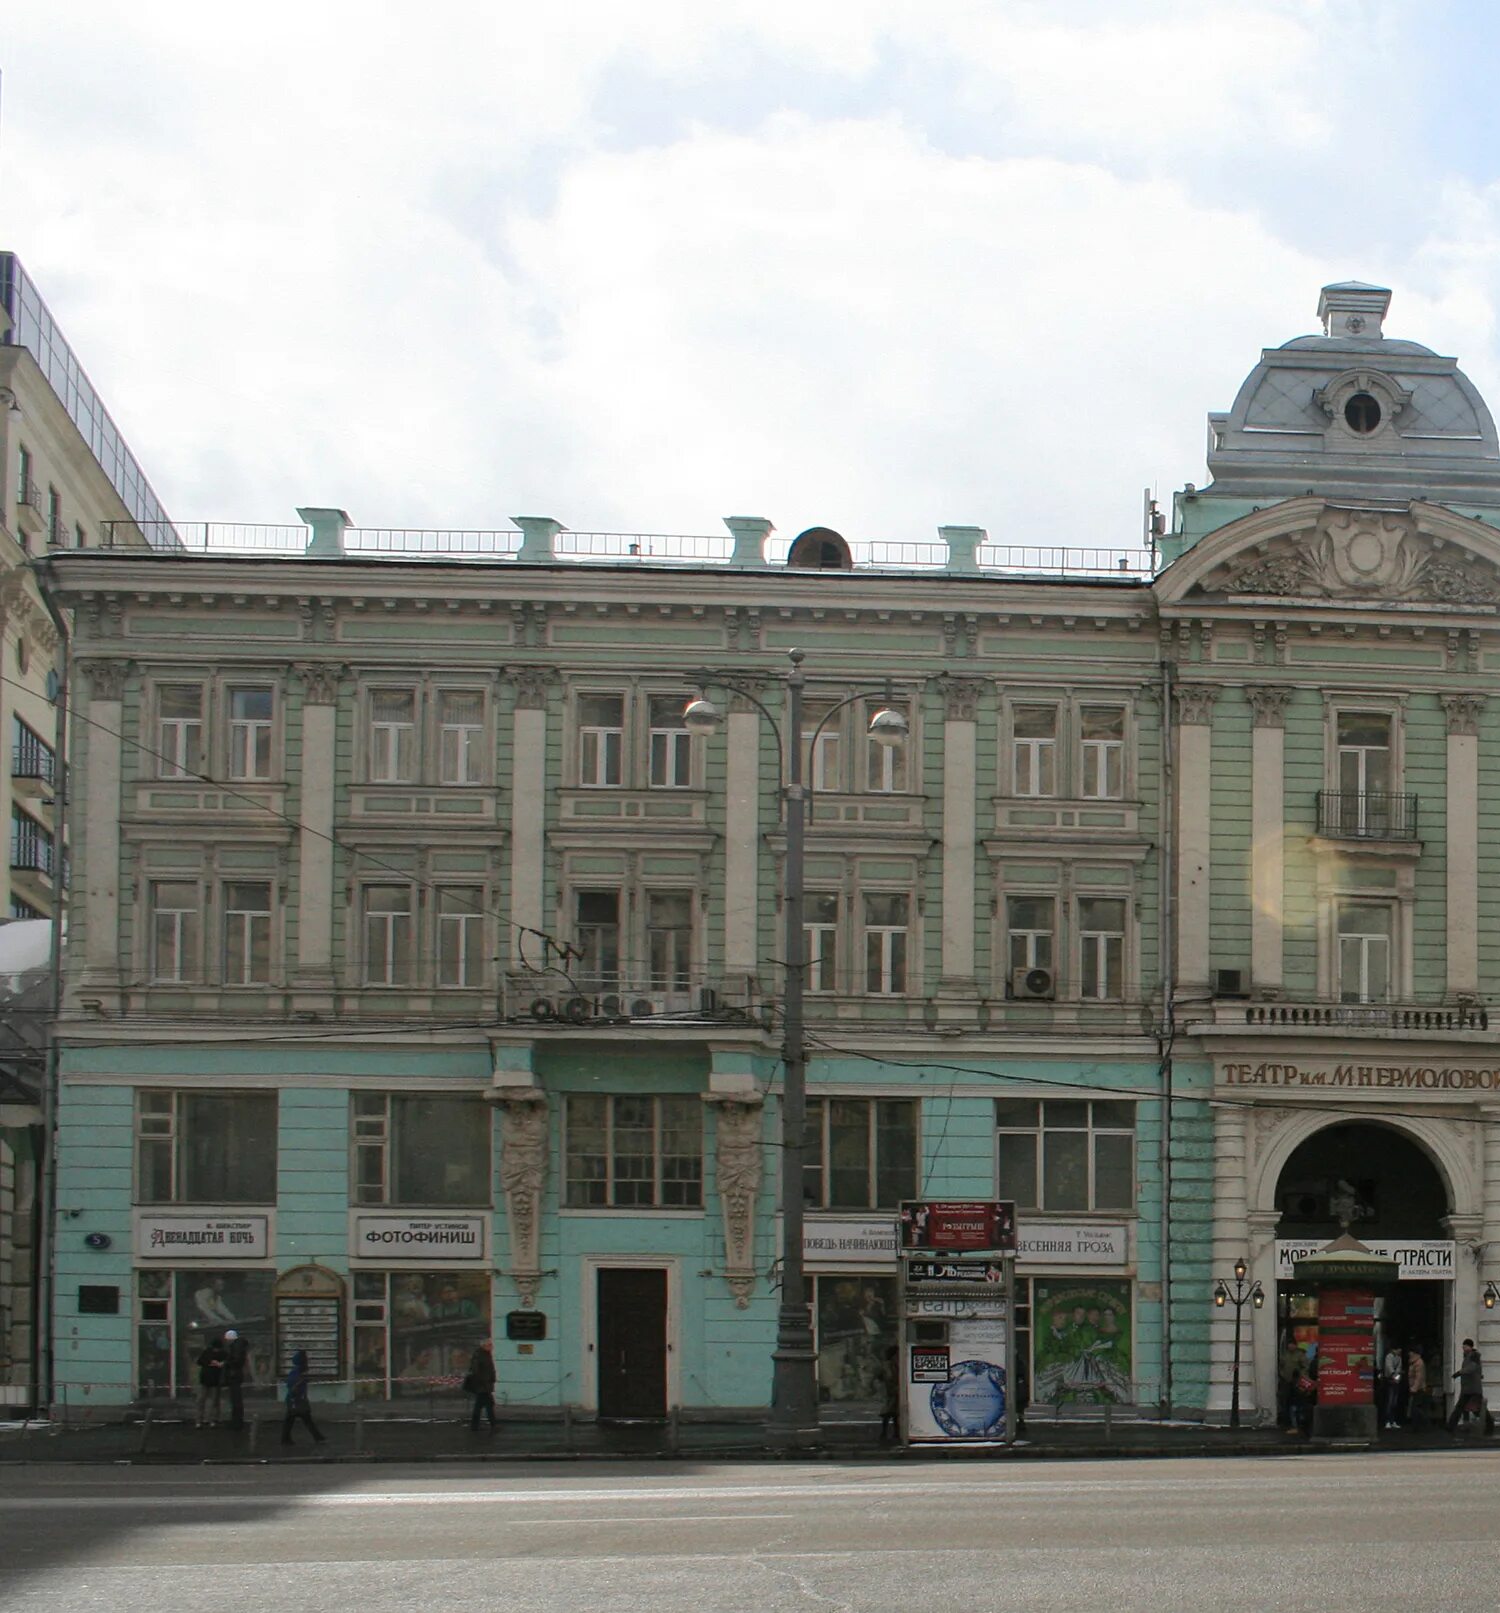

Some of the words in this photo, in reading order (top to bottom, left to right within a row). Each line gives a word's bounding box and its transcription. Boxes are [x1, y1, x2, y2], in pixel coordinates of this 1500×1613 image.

[1222, 1062, 1298, 1085] ТЕАТР
[366, 1230, 476, 1244] ФОТОФИНИШ
[804, 1239, 837, 1250] ПОВЕДЬ
[840, 1239, 897, 1251] НАЧИНАЮЩЕ
[1077, 1241, 1115, 1254] ГРОЗА
[1393, 1249, 1452, 1266] СТРАСТИ
